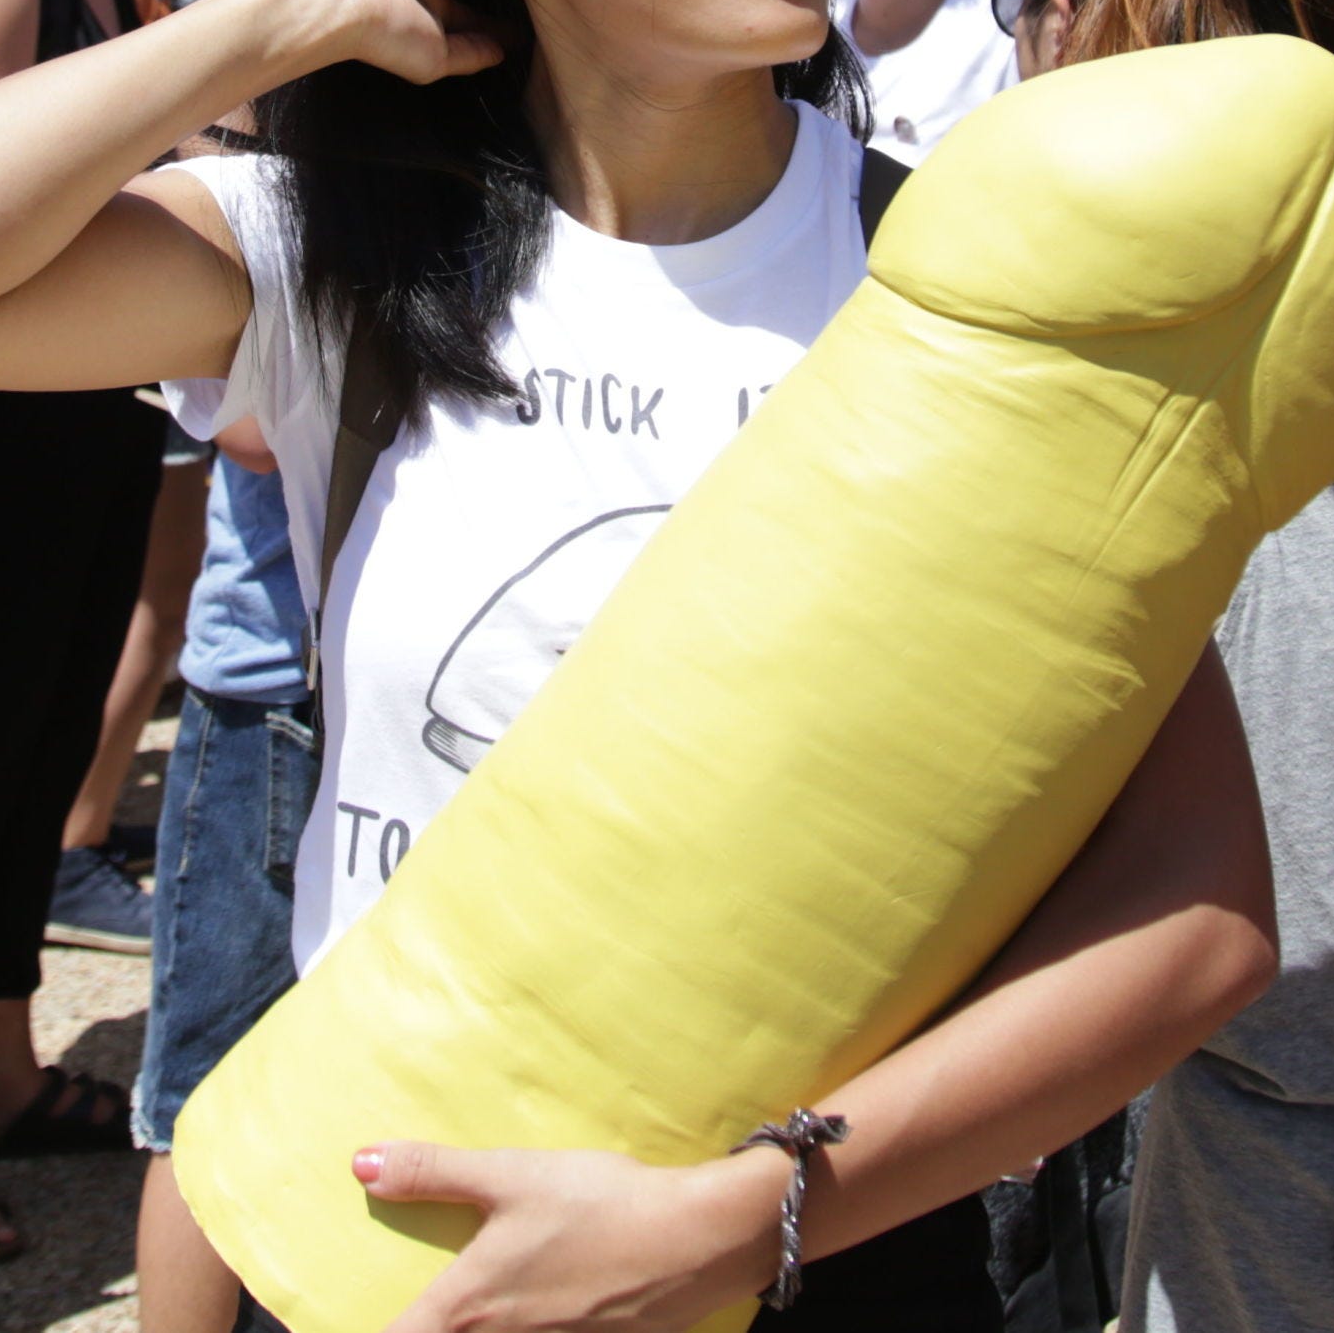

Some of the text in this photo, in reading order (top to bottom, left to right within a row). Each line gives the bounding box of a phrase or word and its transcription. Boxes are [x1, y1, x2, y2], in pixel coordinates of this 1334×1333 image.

[516, 367, 775, 440] STICK I
[337, 801, 410, 885] TO
